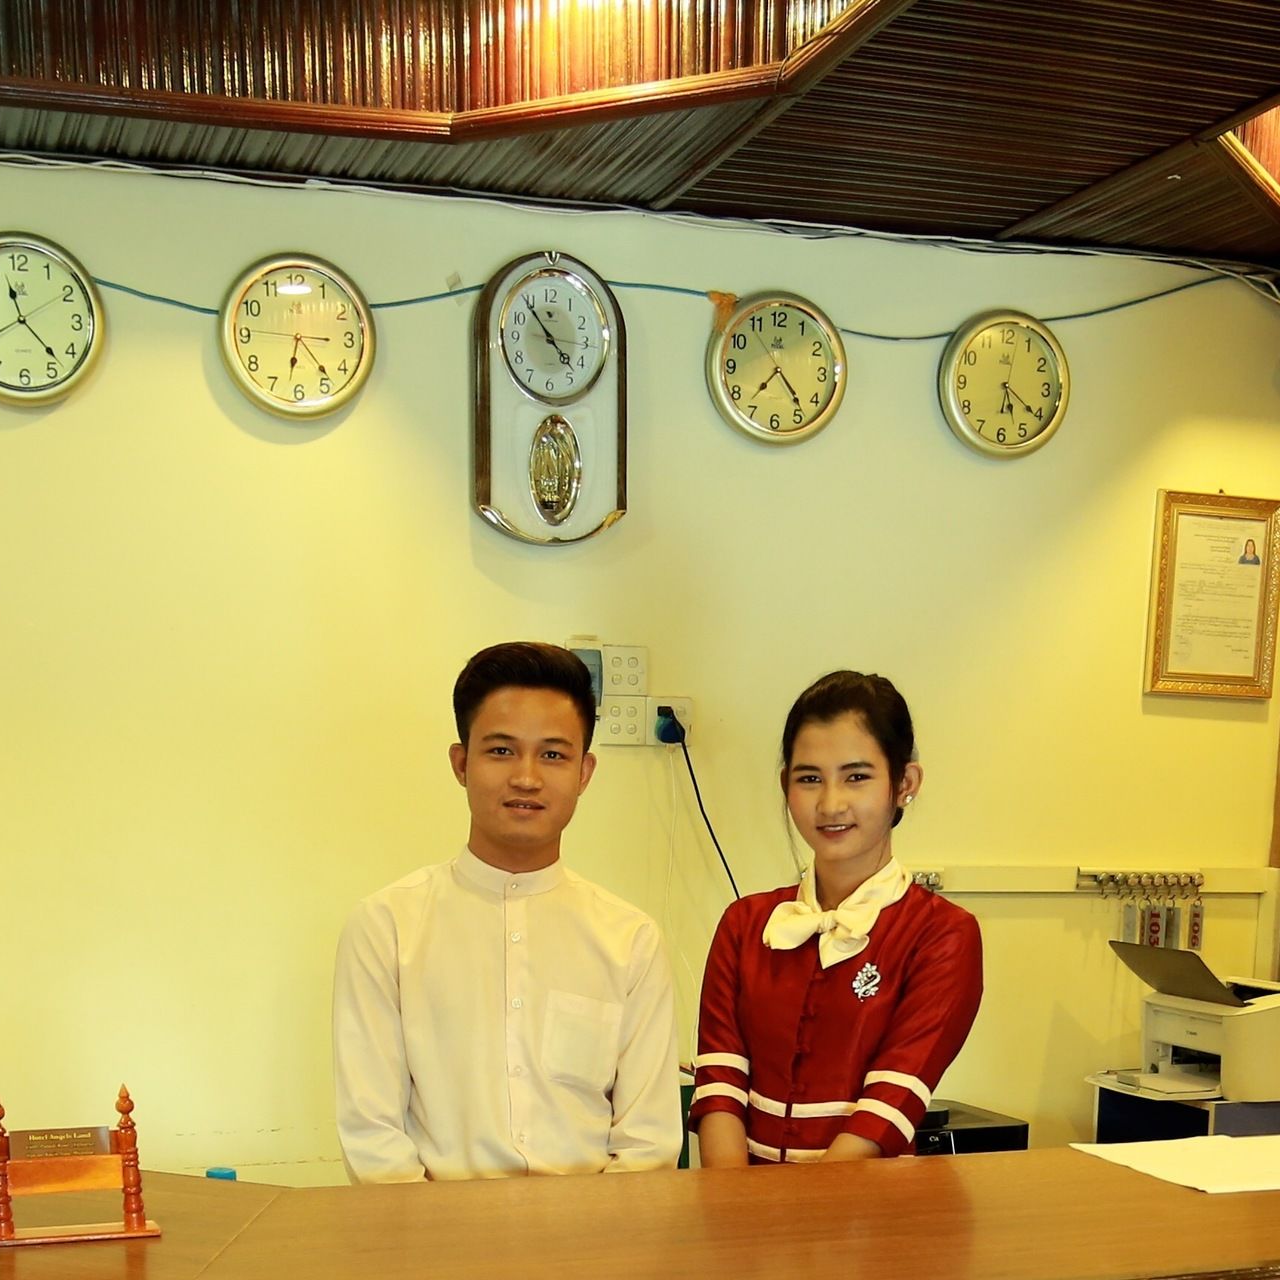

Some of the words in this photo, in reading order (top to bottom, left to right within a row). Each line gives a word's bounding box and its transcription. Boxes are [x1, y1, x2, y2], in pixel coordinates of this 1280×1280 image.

[8, 253, 29, 272] 12
[62, 285, 74, 303] 2
[262, 280, 278, 297] 11
[544, 288, 557, 303] 12
[242, 299, 261, 317] 10
[336, 303, 347, 321] 2
[71, 313, 83, 331] 3
[513, 311, 526, 326] 10
[577, 316, 586, 330] 2
[749, 316, 763, 332] 11
[770, 311, 788, 328] 12
[239, 327, 251, 344] 9
[343, 331, 355, 348] 3
[511, 330, 520, 344] 9
[581, 336, 589, 350] 3
[731, 333, 747, 350] 10
[981, 335, 992, 349] 11
[999, 329, 1015, 345] 12
[65, 342, 77, 359] 4
[812, 341, 823, 357] 2
[963, 348, 977, 366] 10
[248, 354, 259, 372] 8
[514, 351, 524, 365] 8
[576, 355, 585, 369] 4
[1036, 357, 1047, 373] 2
[46, 362, 58, 379] 5
[337, 359, 348, 375] 4
[726, 358, 736, 375] 9
[816, 366, 827, 382] 3
[19, 368, 31, 386] 6
[525, 368, 534, 383] 7
[565, 372, 574, 385] 5
[957, 374, 967, 390] 9
[267, 376, 278, 392] 7
[319, 378, 331, 394] 5
[545, 378, 554, 391] 6
[1041, 382, 1051, 398] 3
[293, 384, 305, 401] 6
[731, 385, 741, 401] 8
[810, 392, 820, 407] 4
[747, 405, 758, 420] 7
[961, 399, 971, 415] 8
[1034, 407, 1044, 421] 4
[769, 414, 780, 430] 6
[792, 408, 803, 424] 5
[977, 419, 986, 433] 7
[1017, 423, 1027, 438] 5
[996, 427, 1006, 443] 6
[1149, 911, 1160, 946] 103
[1191, 913, 1200, 947] 106
[28, 1133, 48, 1141] Hotel
[49, 1132, 72, 1141] Angels
[73, 1131, 91, 1139] Land
